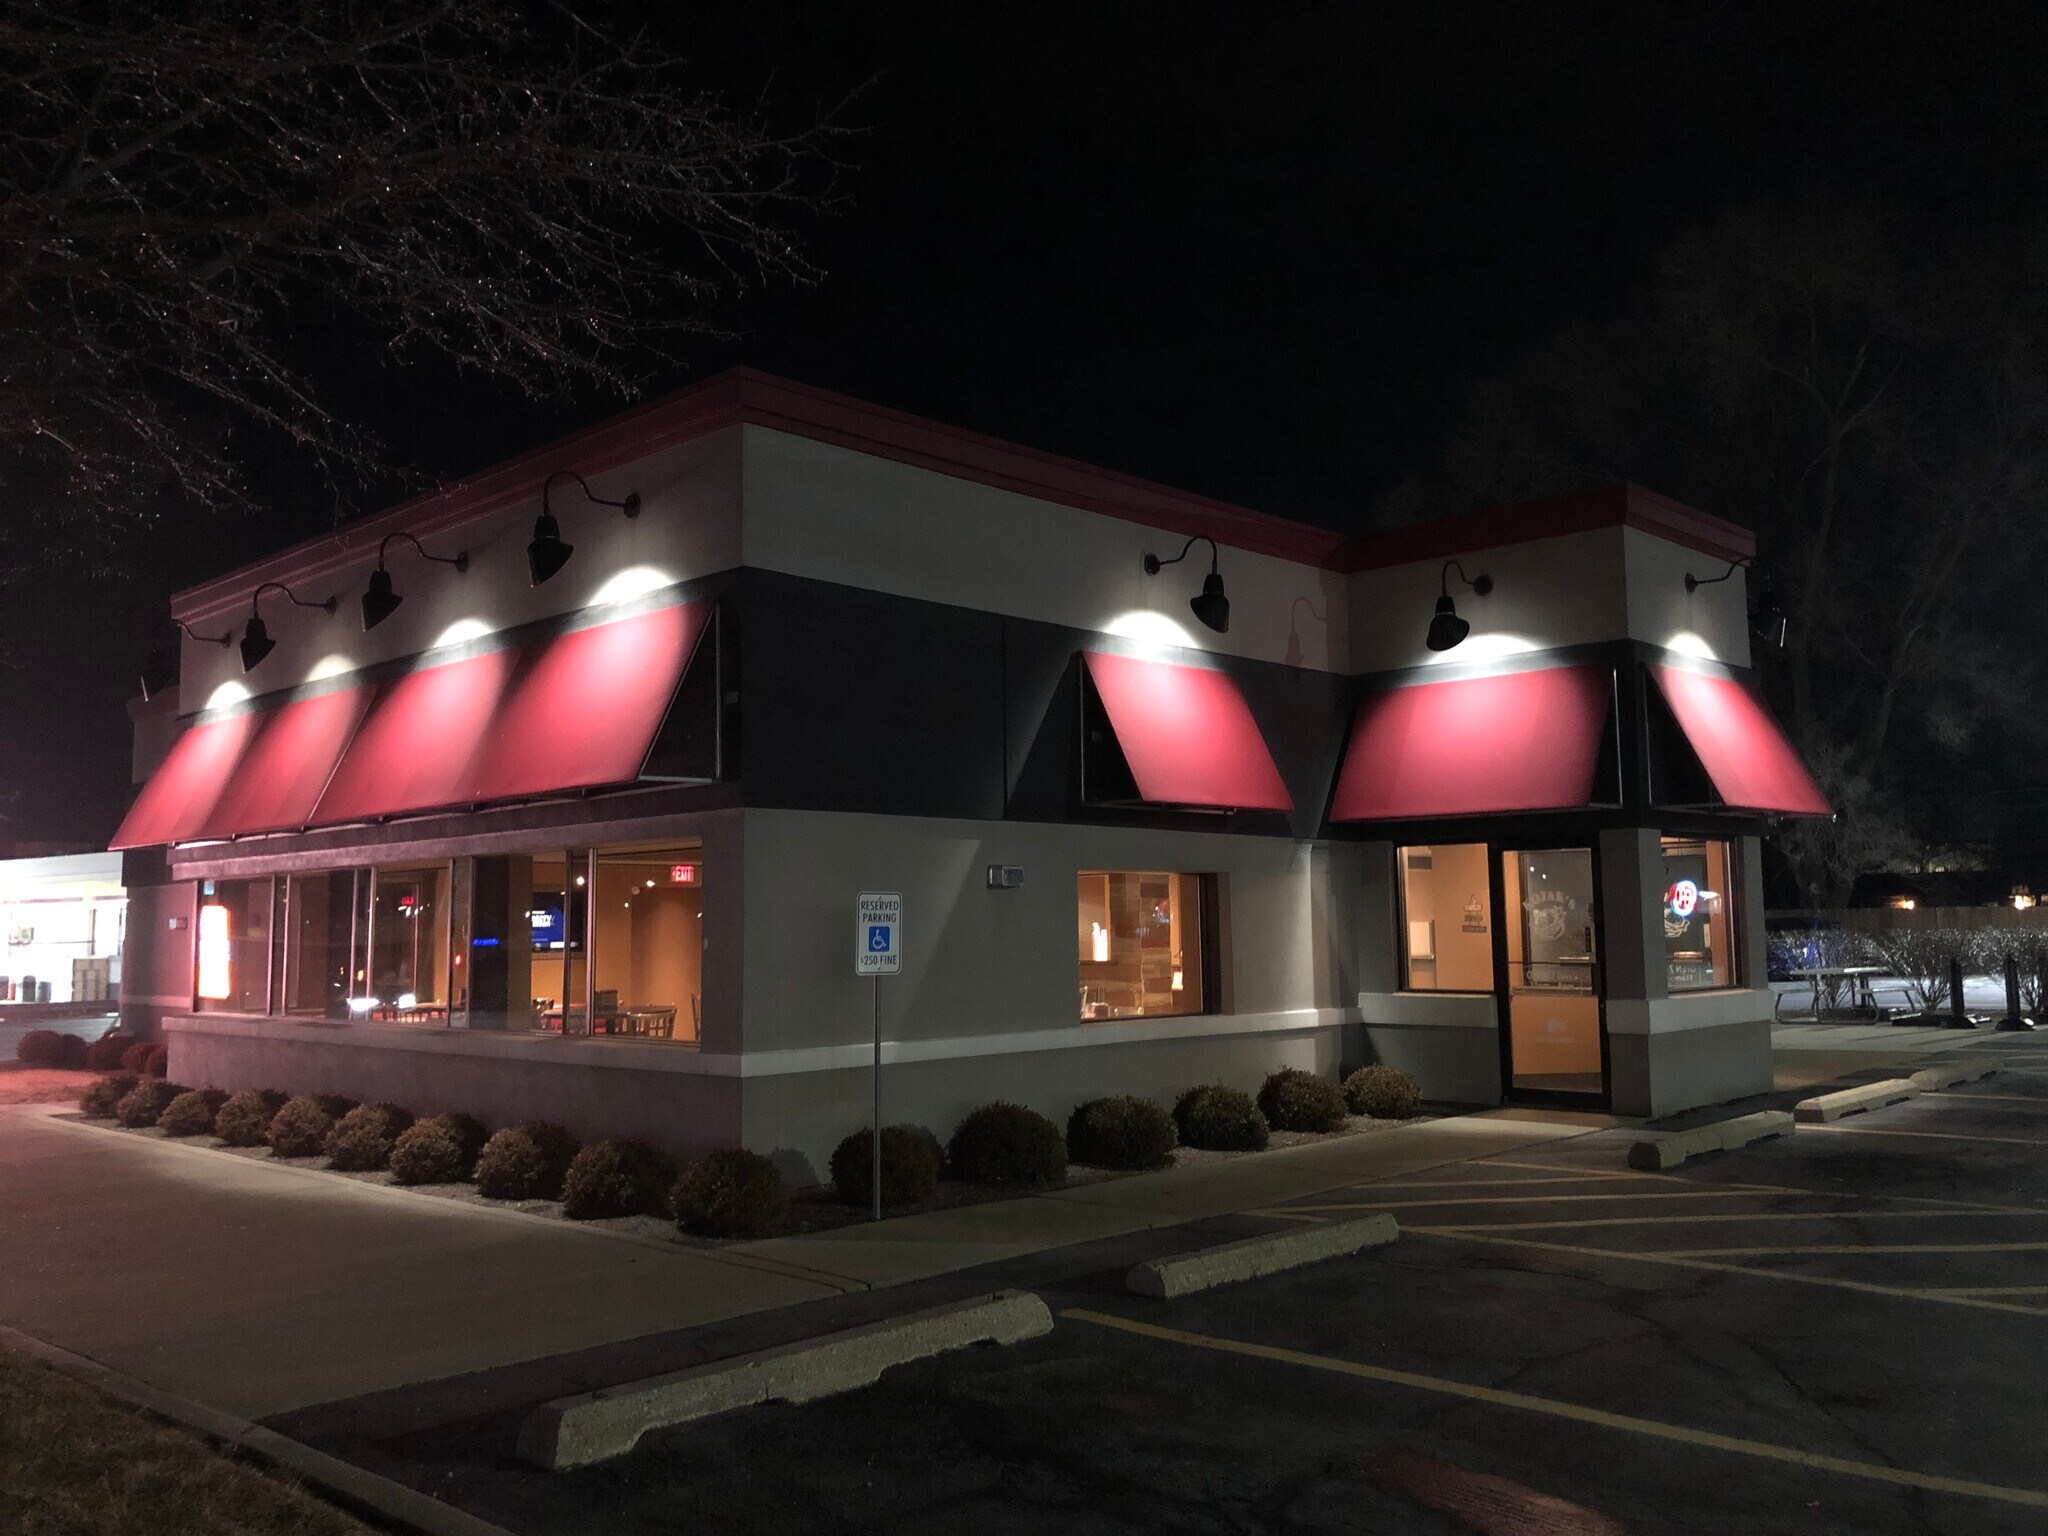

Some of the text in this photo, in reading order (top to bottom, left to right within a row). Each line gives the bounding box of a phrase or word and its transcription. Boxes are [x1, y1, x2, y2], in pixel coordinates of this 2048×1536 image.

[861, 901, 899, 911] RESERVED
[863, 913, 896, 923] PARKING
[880, 954, 897, 965] FINE
